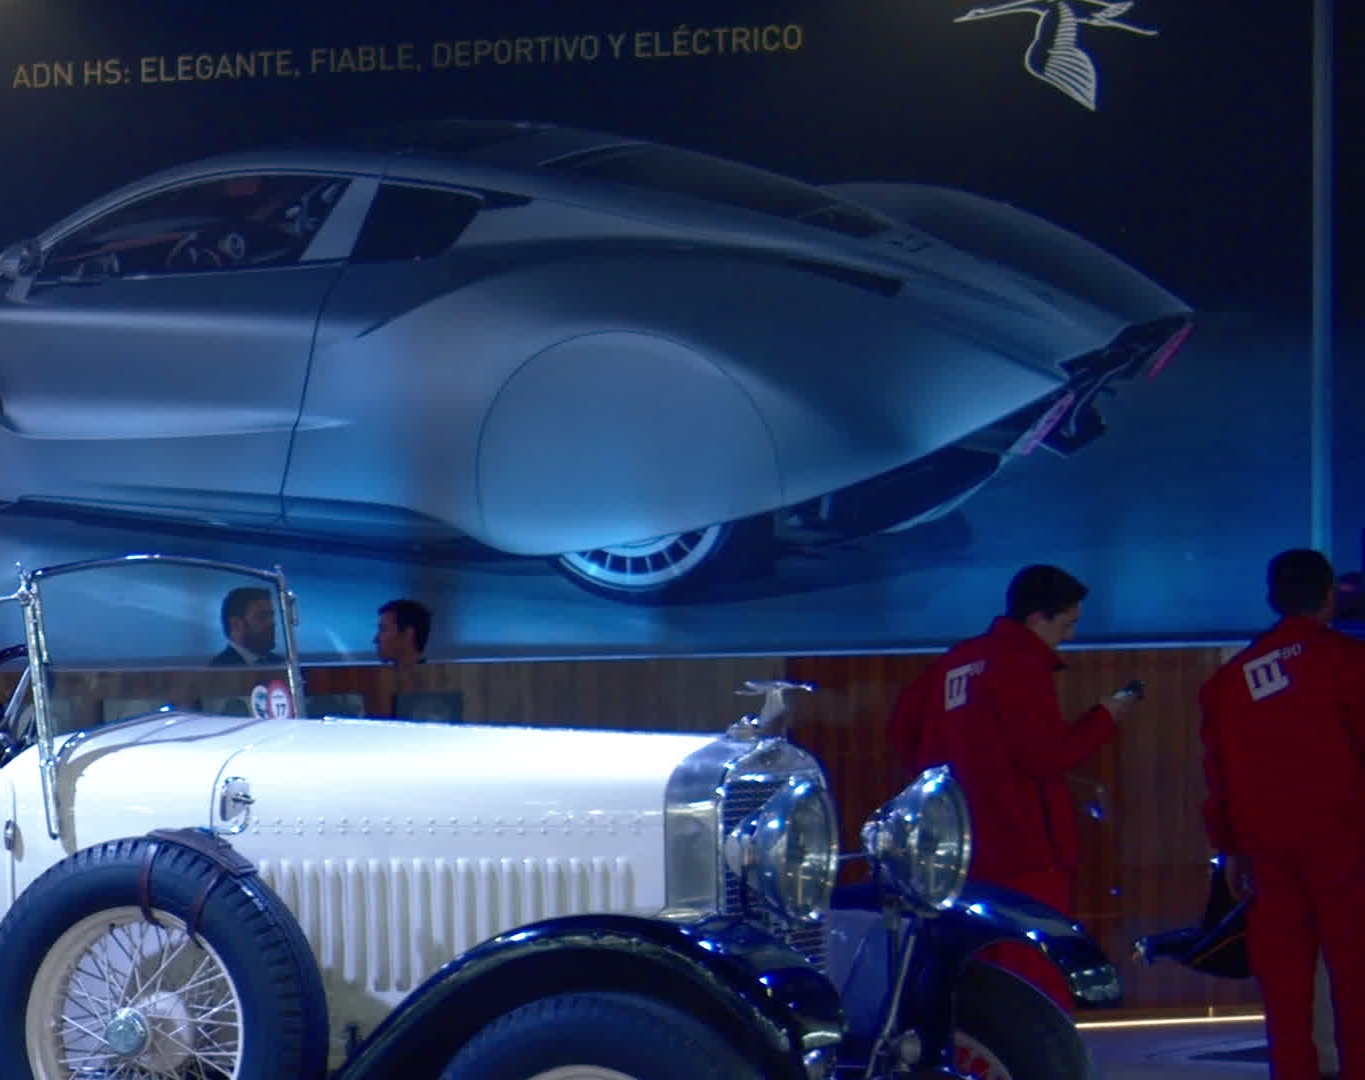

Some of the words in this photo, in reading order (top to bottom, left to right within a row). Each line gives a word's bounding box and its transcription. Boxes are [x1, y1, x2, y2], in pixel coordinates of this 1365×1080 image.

[12, 63, 73, 89] ADN
[82, 58, 132, 85] HS:
[139, 50, 301, 83] ELEGANTE,
[310, 43, 423, 74] FIABLE,
[433, 34, 600, 69] DEPORTIVO
[607, 33, 628, 59] Y
[634, 24, 805, 58] ELÉCTRICO
